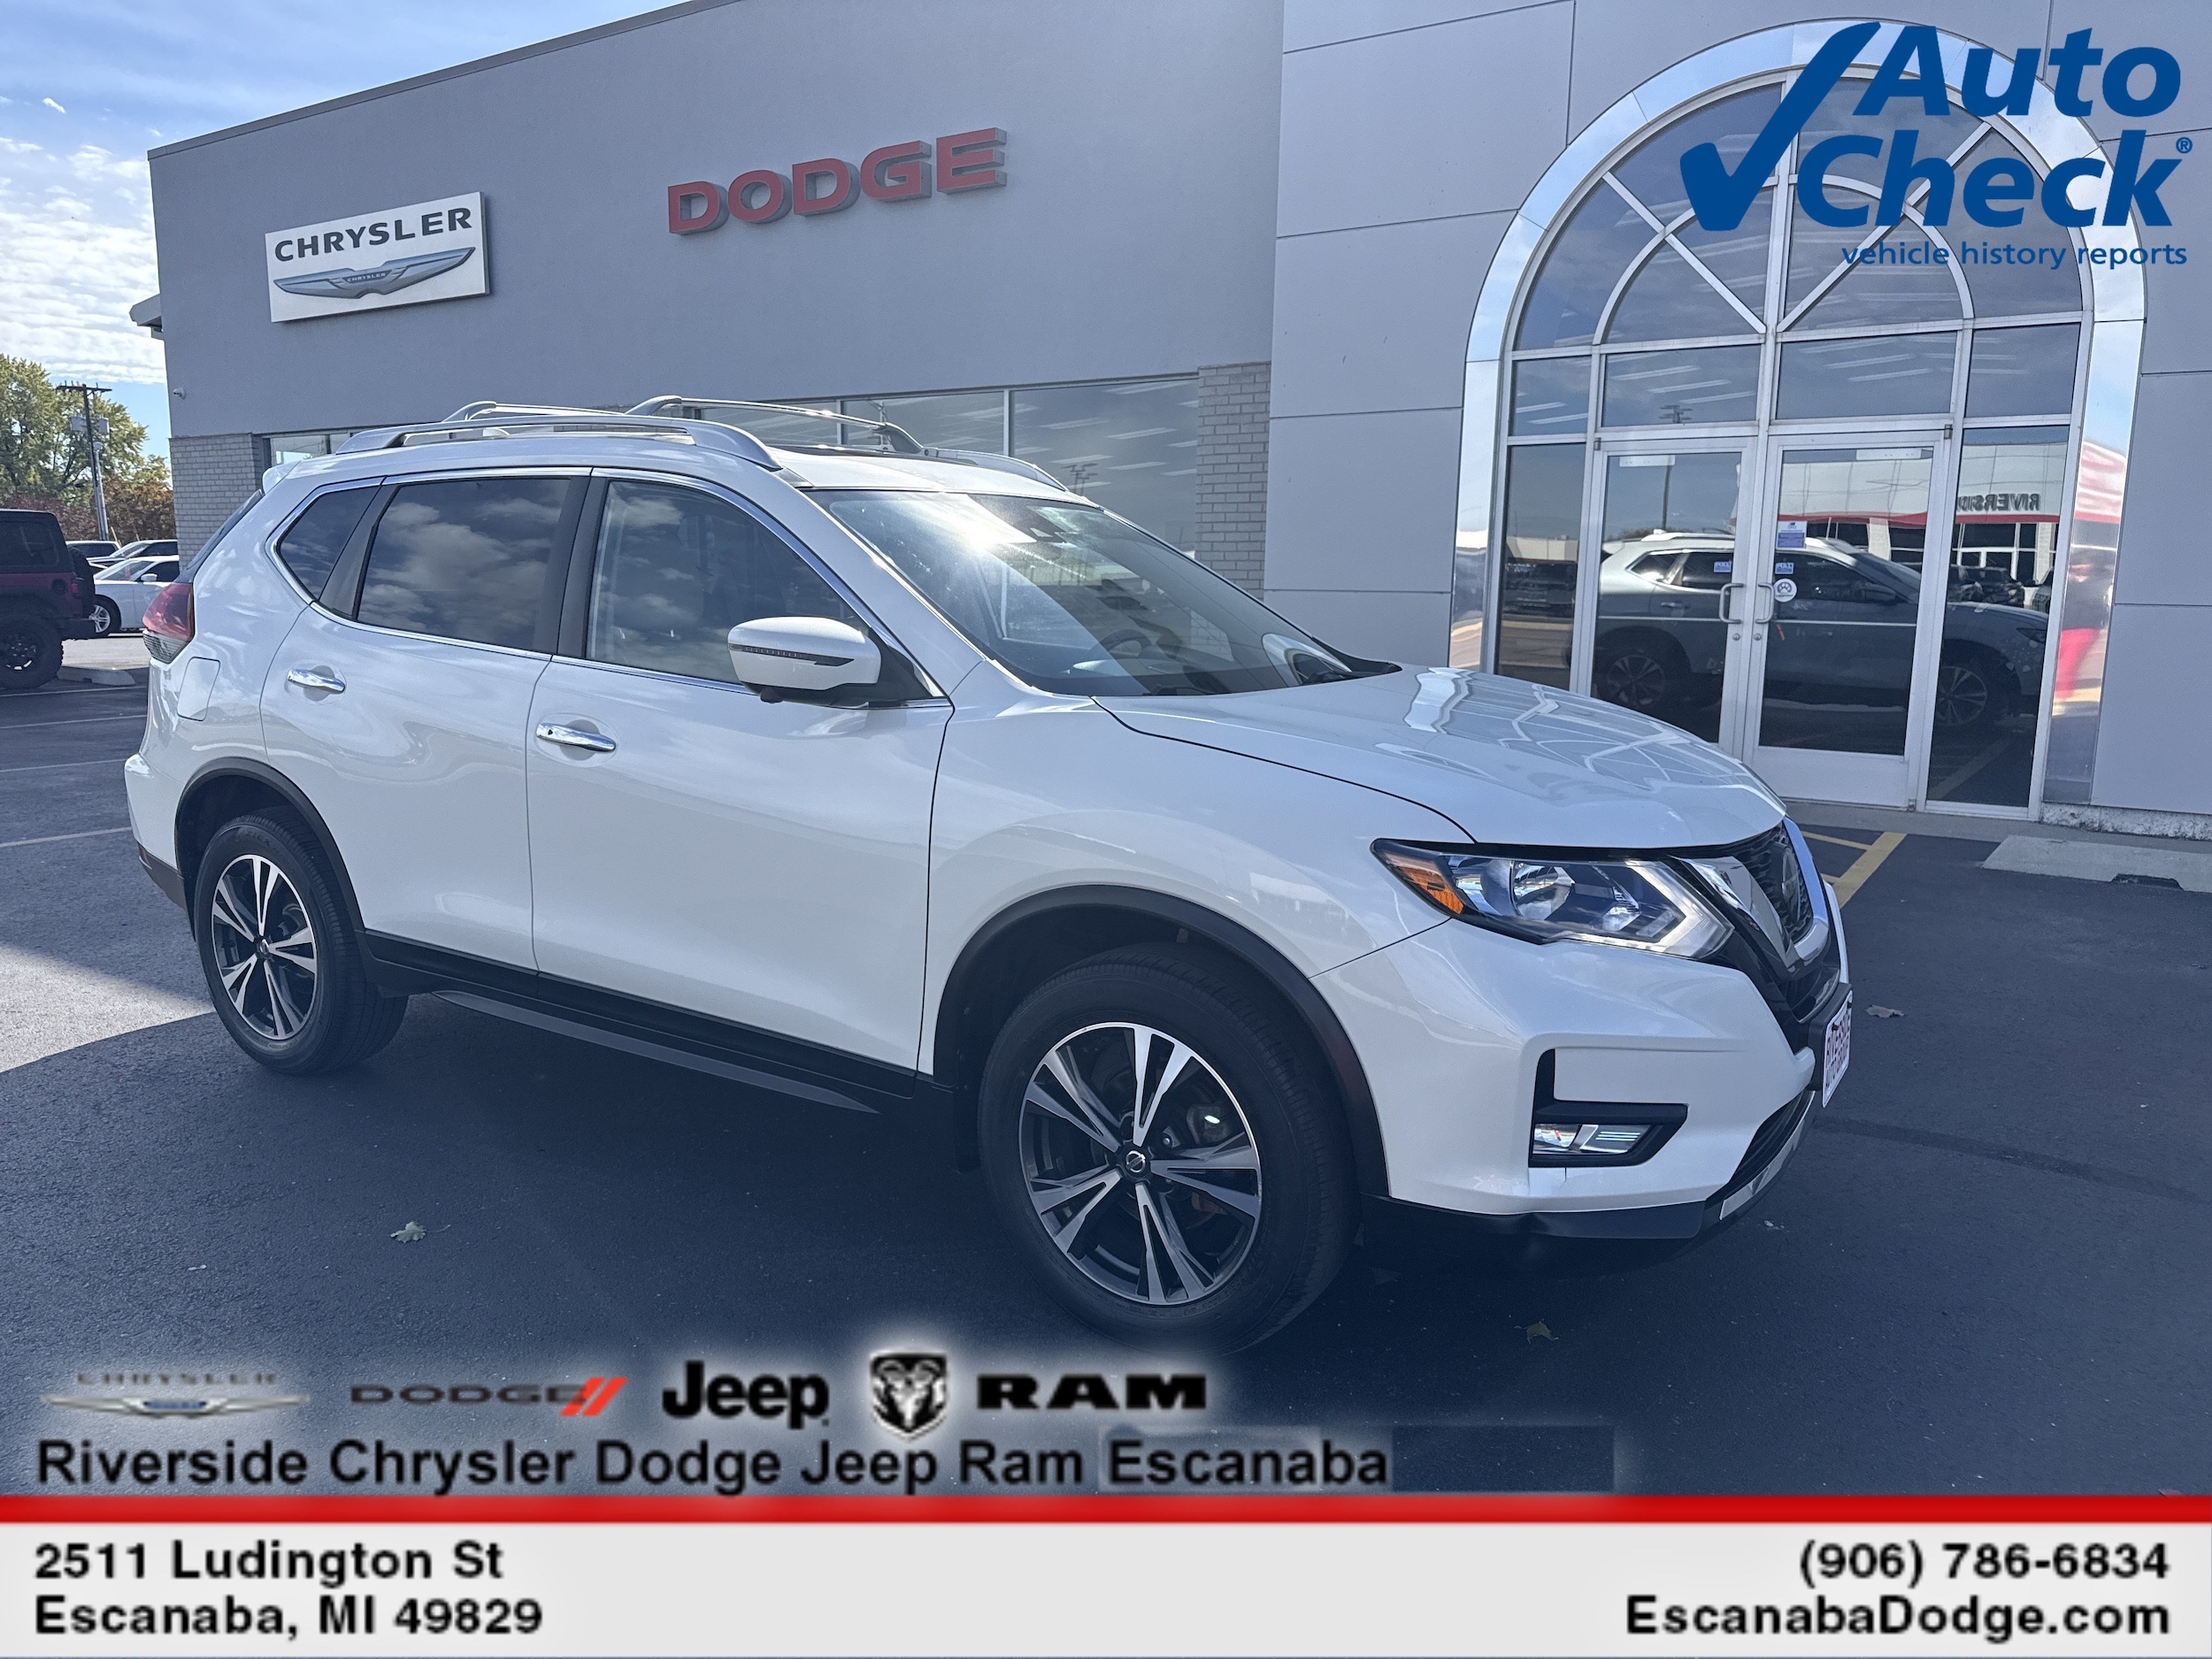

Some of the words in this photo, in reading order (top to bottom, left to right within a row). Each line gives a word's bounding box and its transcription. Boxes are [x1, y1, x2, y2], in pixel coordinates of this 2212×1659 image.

[667, 127, 1008, 235] DODGE
[274, 207, 473, 263] CHRYSLER
[347, 272, 387, 283] CHRYSLER
